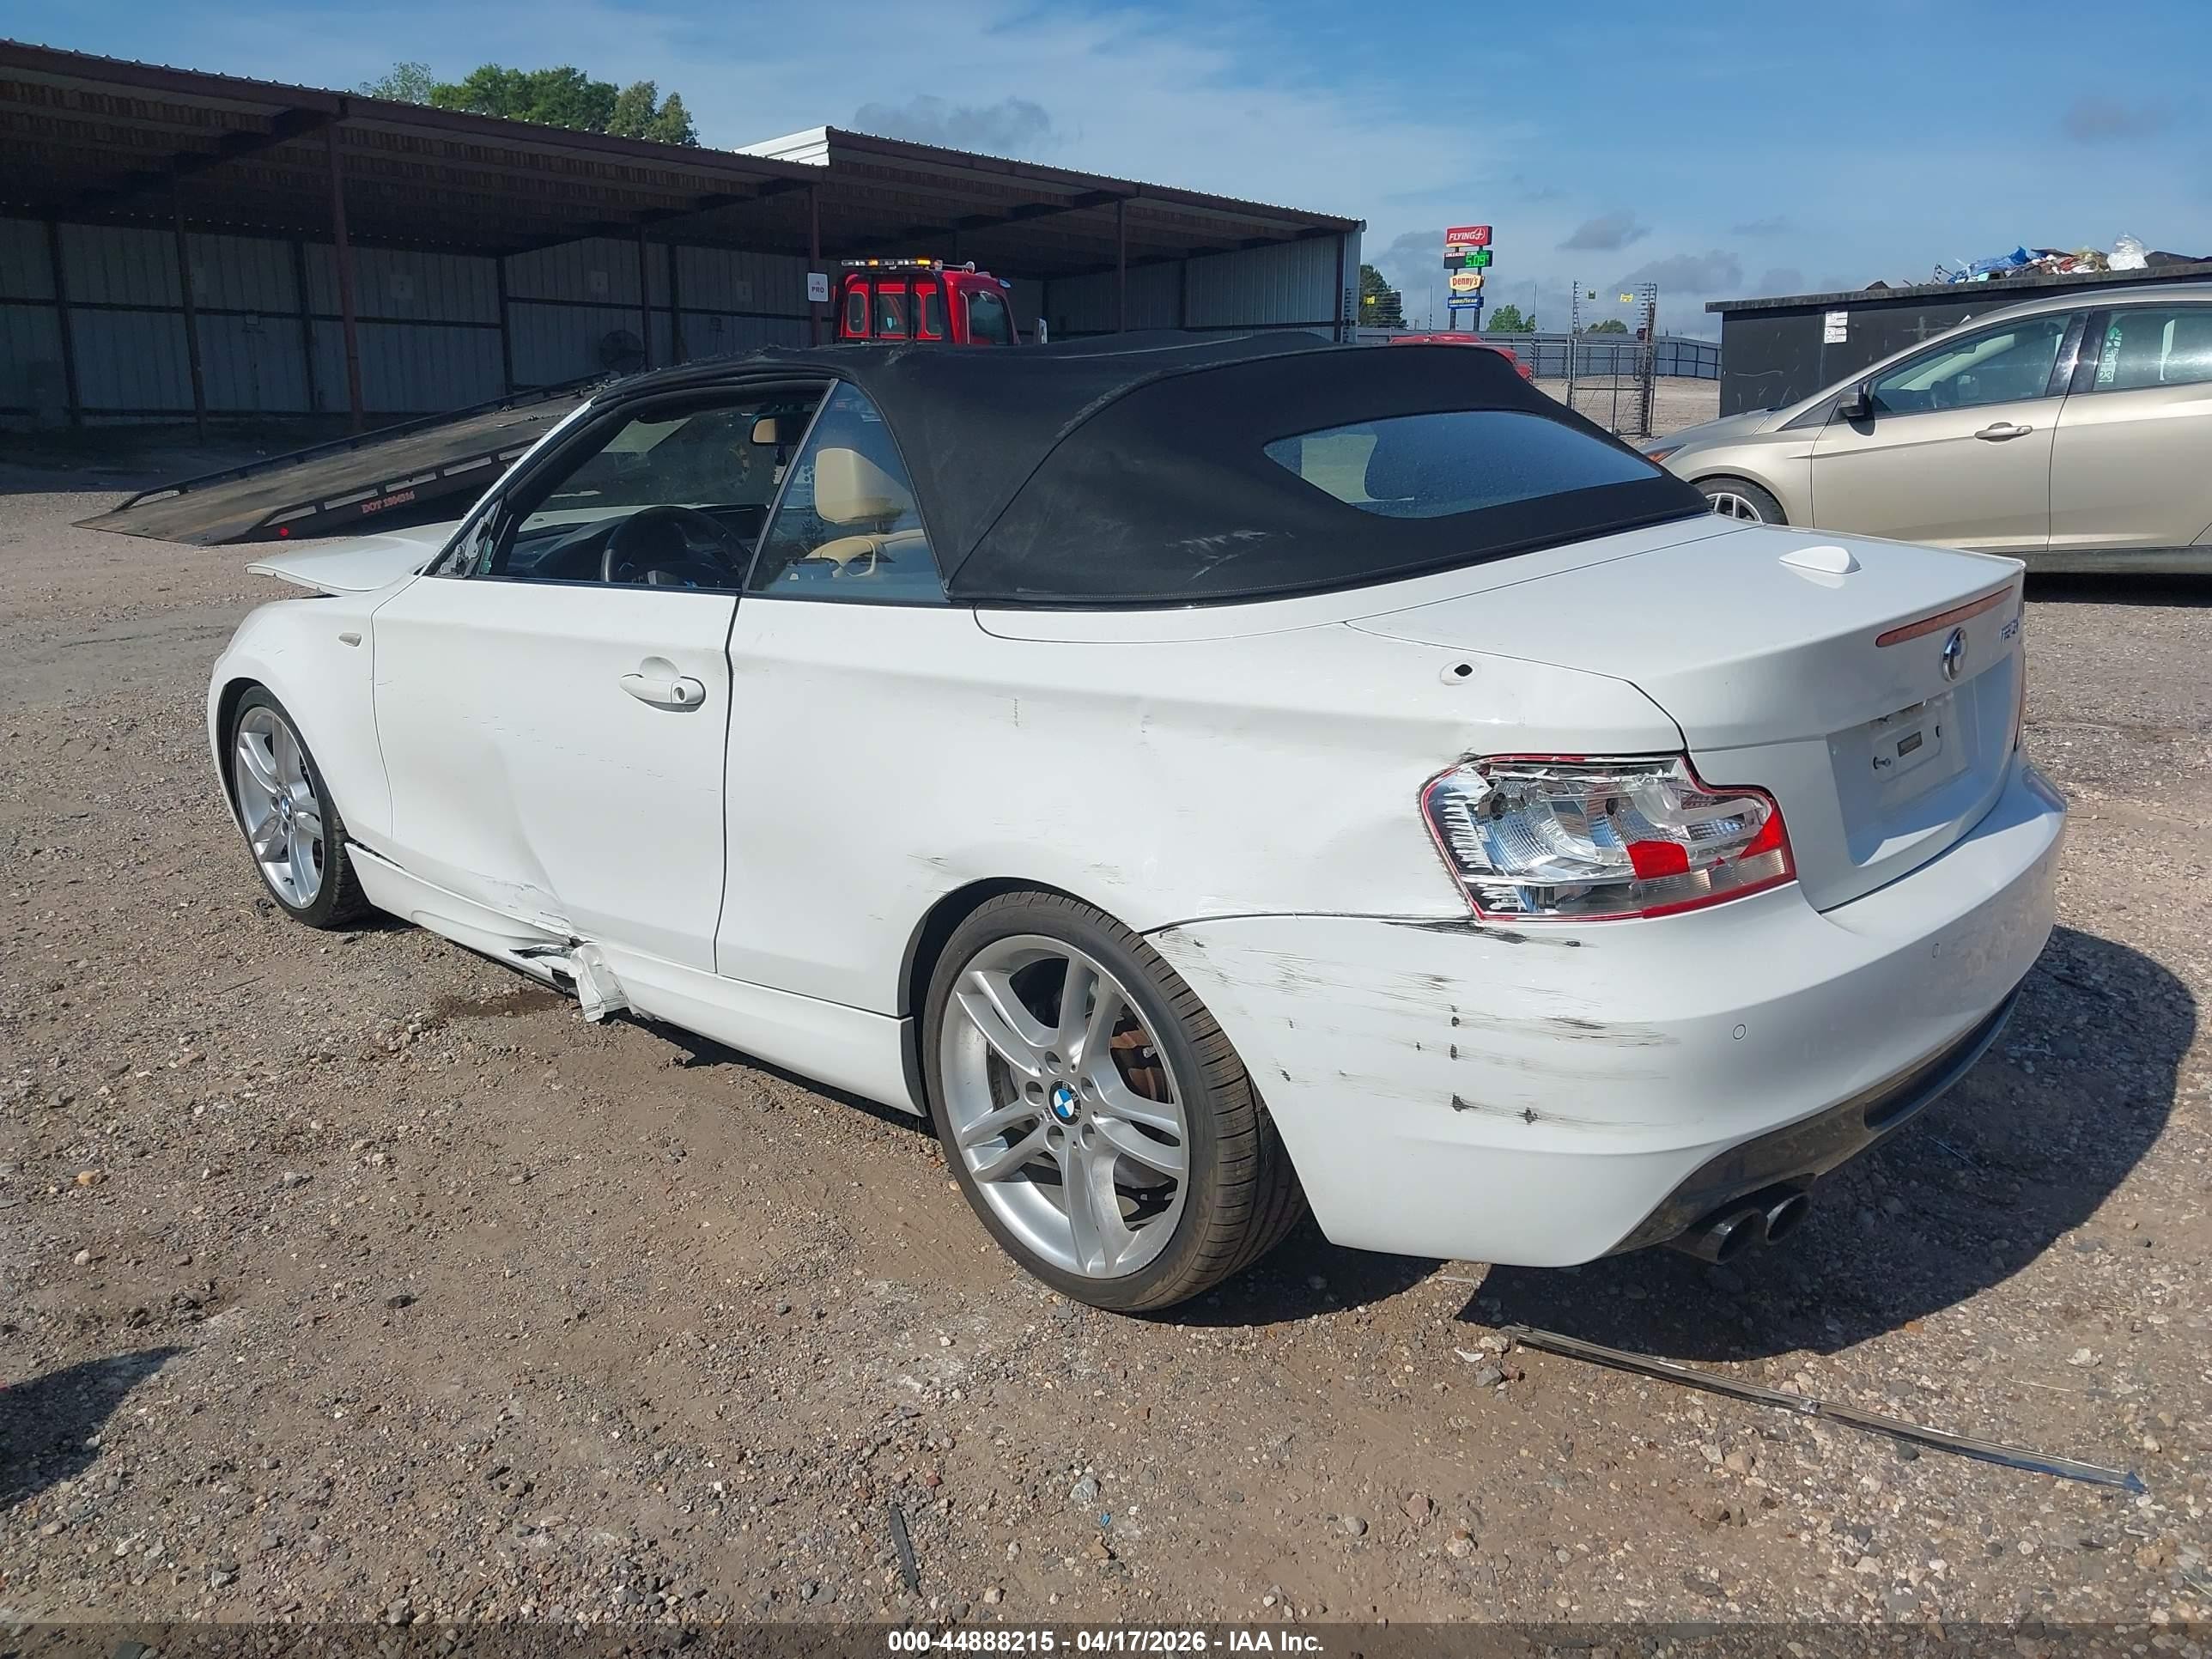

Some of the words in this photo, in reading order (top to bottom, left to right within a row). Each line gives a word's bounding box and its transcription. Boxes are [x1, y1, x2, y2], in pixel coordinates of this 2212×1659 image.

[1452, 276, 1478, 286] Denny's
[811, 285, 825, 294] PRO
[362, 500, 383, 514] DOT
